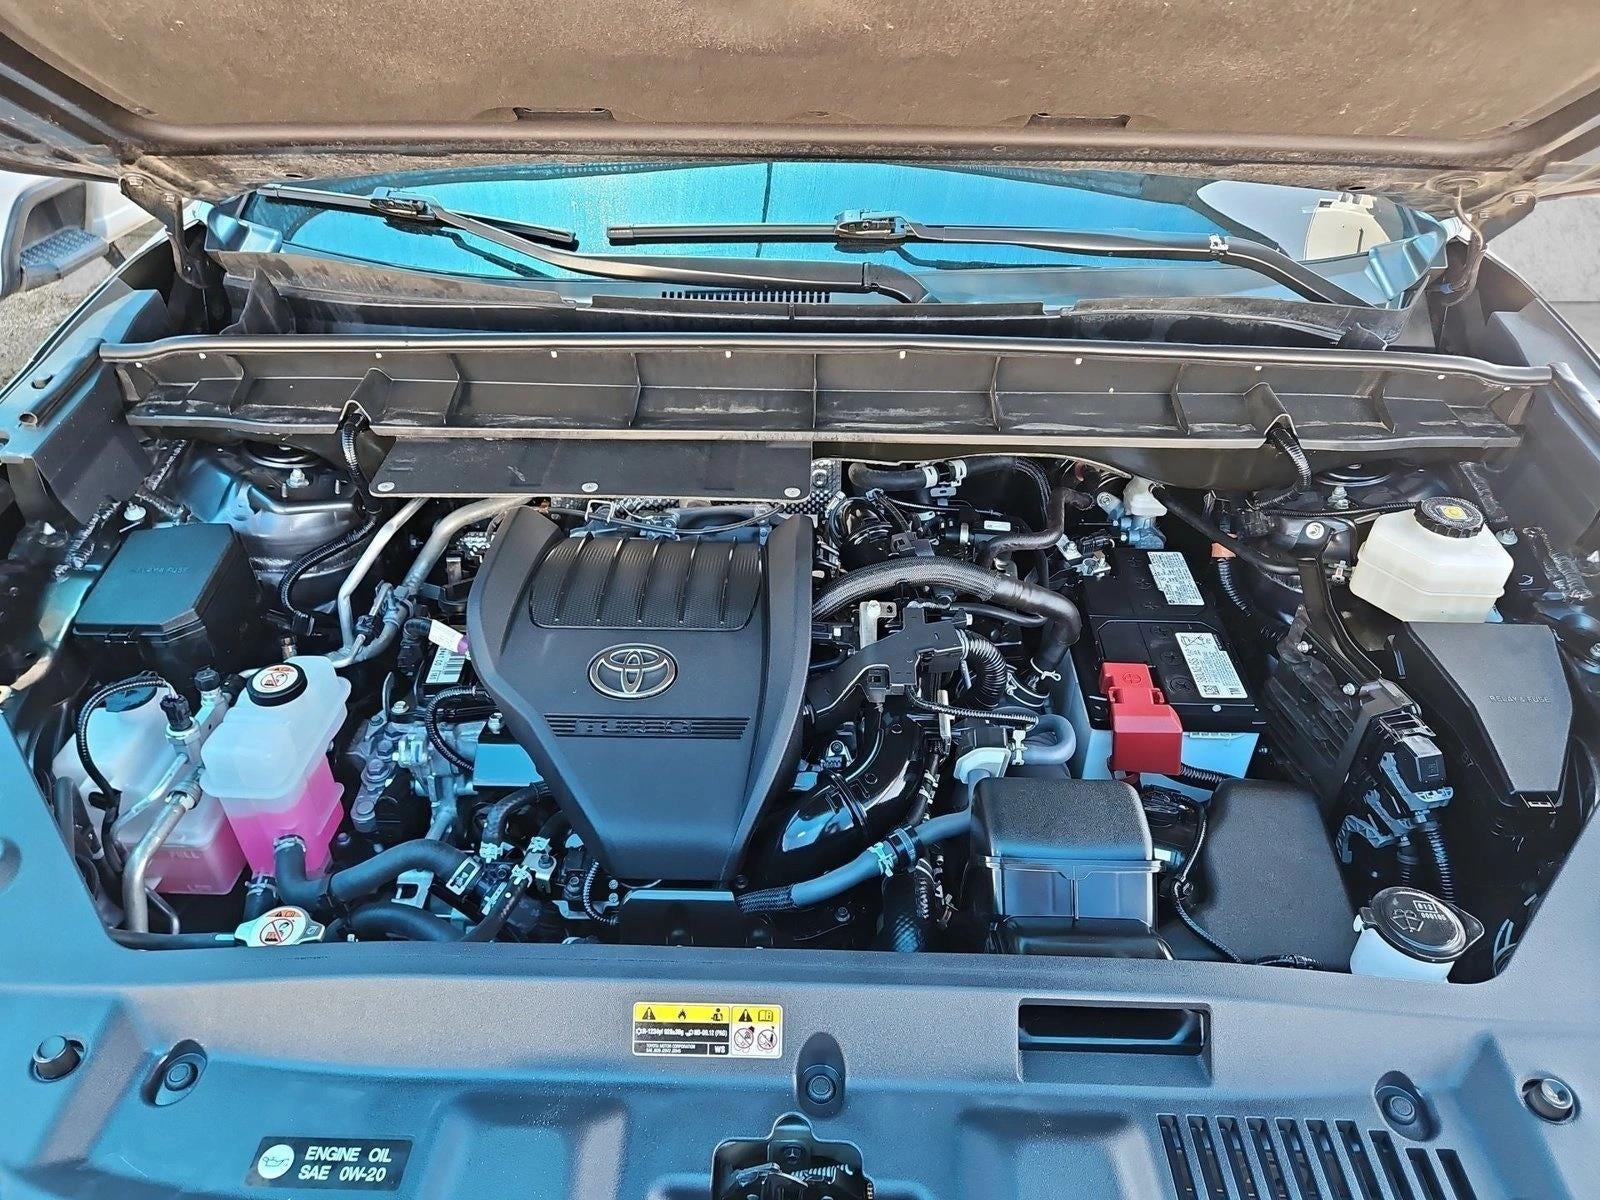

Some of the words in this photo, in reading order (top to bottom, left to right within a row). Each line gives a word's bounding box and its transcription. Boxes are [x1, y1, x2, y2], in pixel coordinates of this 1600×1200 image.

[576, 719, 692, 735] TURBO
[304, 1146, 362, 1162] ENGINE
[368, 1147, 392, 1163] OIL
[298, 1164, 331, 1181] SAE
[339, 1166, 387, 1182] 0W-20
